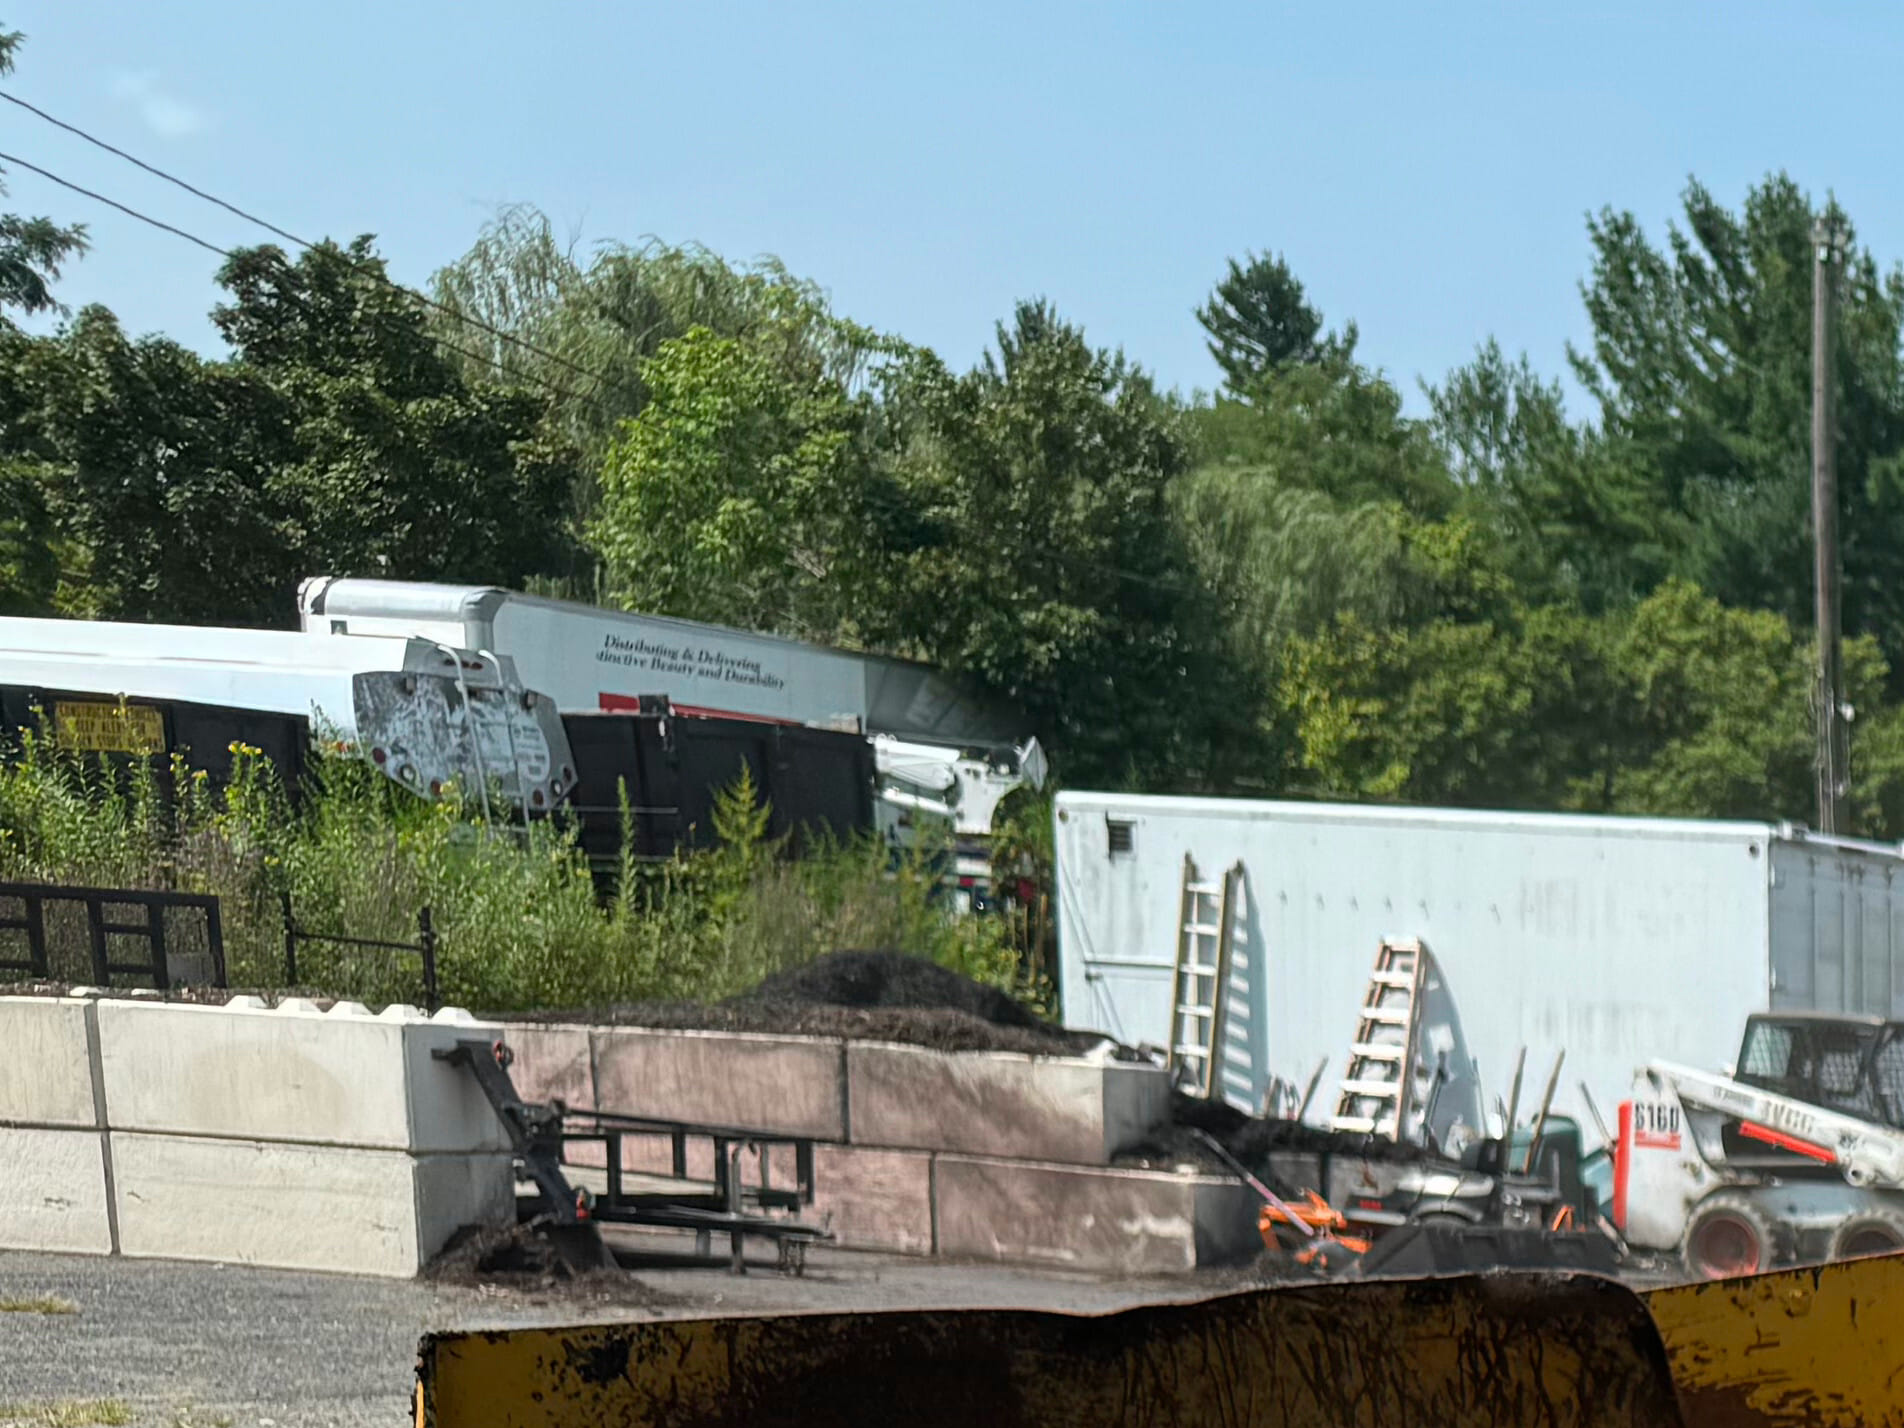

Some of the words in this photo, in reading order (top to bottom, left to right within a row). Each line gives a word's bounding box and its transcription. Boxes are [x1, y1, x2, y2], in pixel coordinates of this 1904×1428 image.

[604, 634, 678, 661] Distributing
[682, 647, 694, 661] &
[699, 649, 761, 673] Delivering
[651, 657, 694, 675] Beauty
[698, 666, 722, 681] and
[725, 668, 784, 690] Durability
